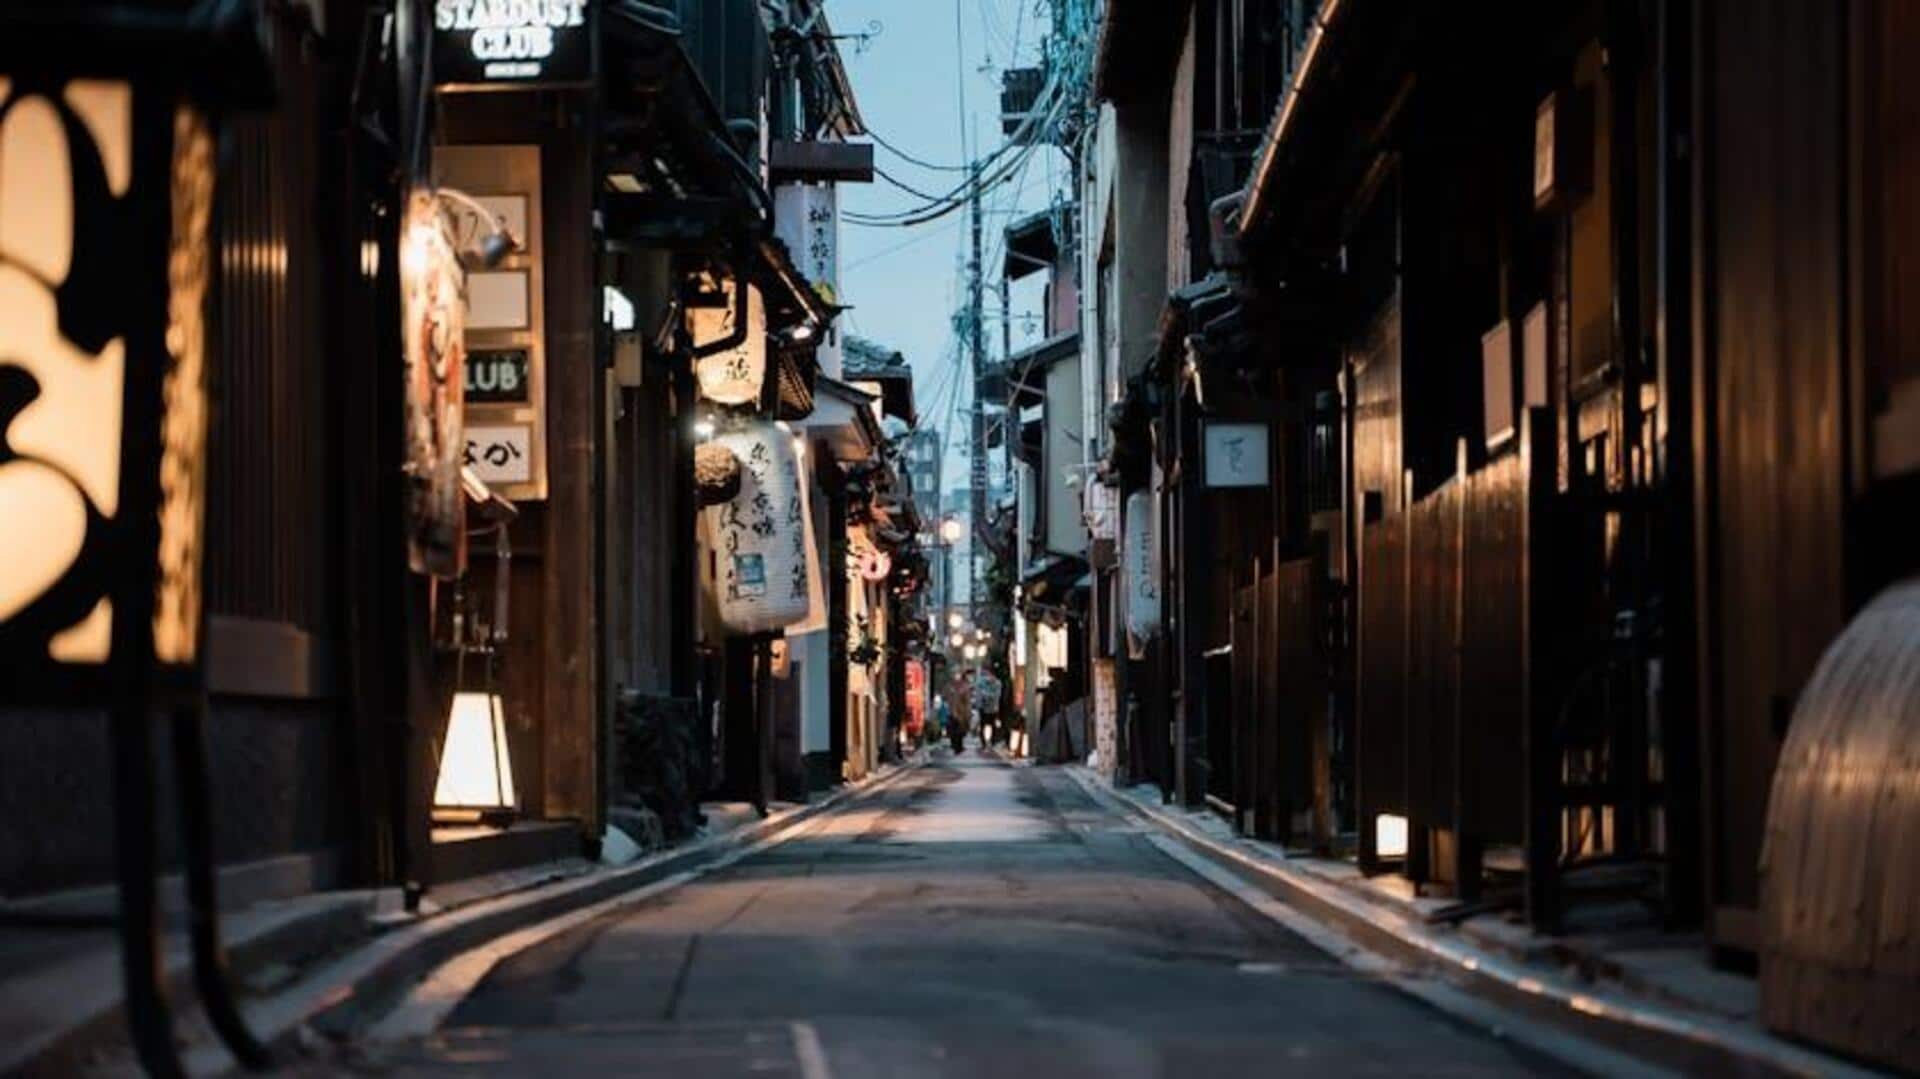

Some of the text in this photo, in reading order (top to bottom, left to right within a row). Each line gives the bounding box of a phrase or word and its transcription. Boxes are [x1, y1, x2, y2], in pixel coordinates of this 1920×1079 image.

[435, 0, 587, 29] STARDUST
[471, 26, 553, 59] CLUB
[463, 360, 519, 391] LUB
